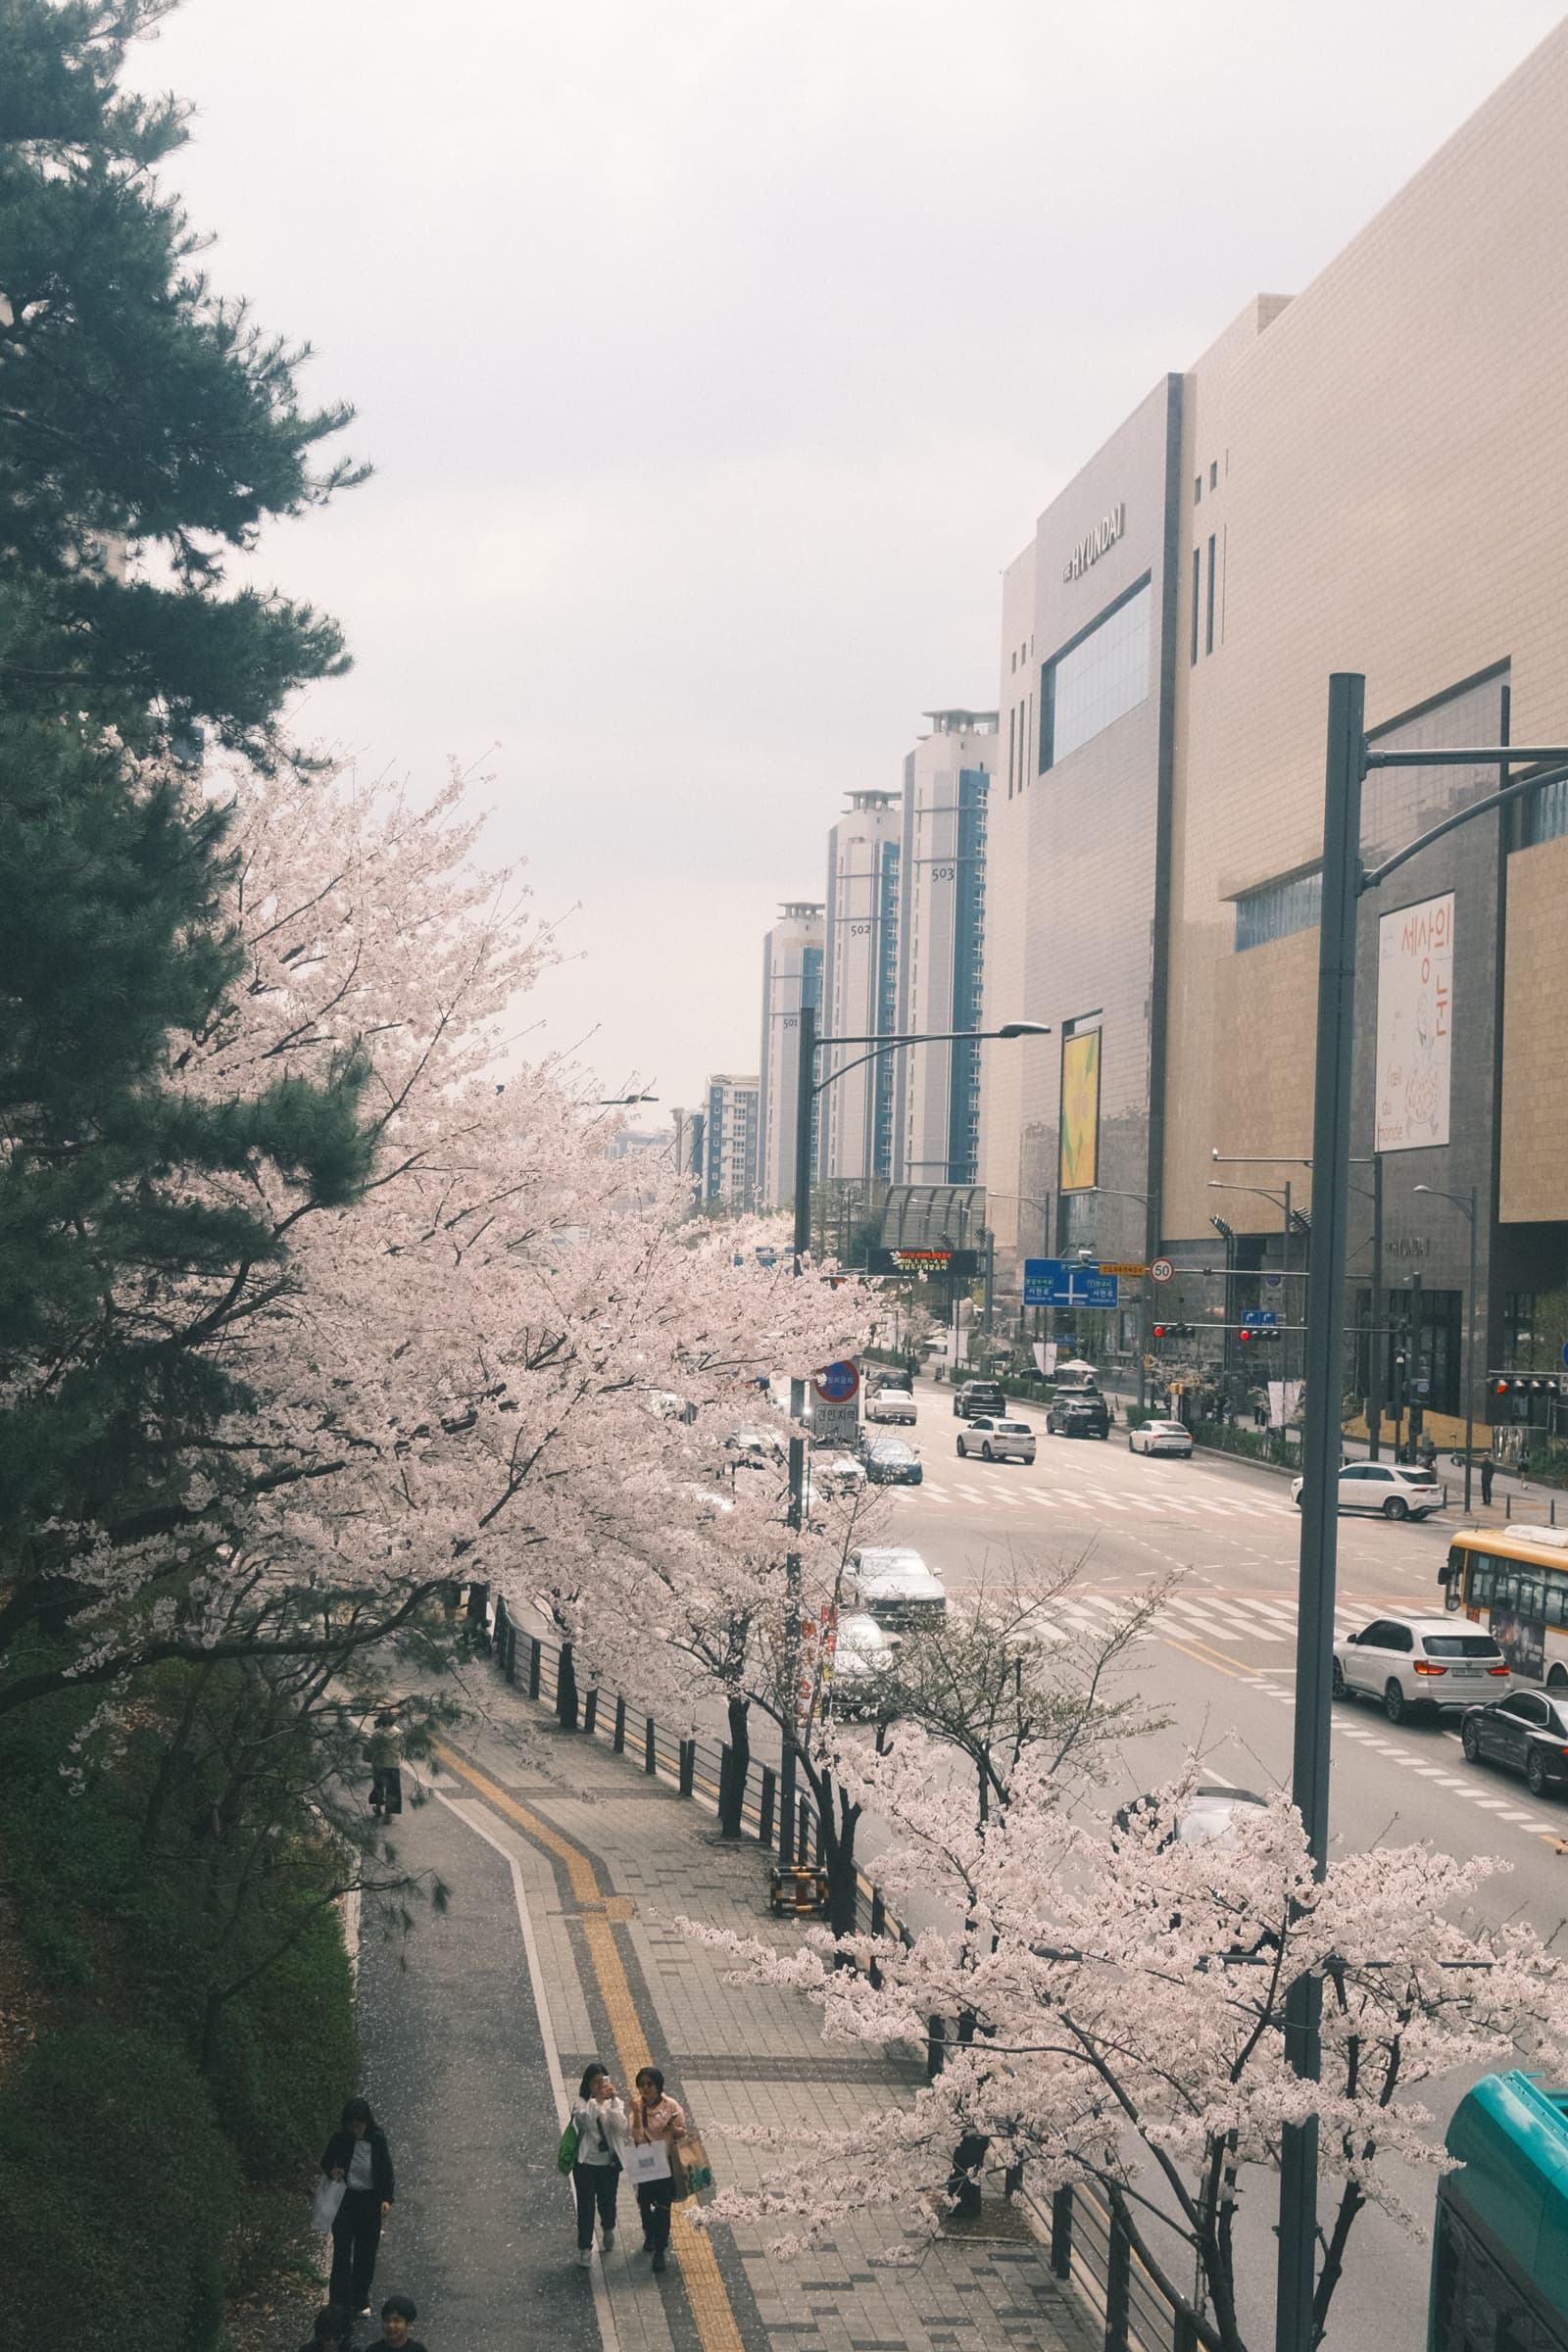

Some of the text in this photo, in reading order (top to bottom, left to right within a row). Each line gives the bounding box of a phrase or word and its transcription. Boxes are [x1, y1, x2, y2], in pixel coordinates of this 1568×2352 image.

[1072, 501, 1125, 581] HYUNDAI
[932, 867, 955, 882] 503
[851, 924, 871, 937] 502
[1400, 902, 1451, 985] 세상의
[783, 1018, 799, 1029] 501
[1154, 1264, 1170, 1277] 50
[1028, 1288, 1050, 1297] 서현로
[1093, 1290, 1114, 1298] 서현로
